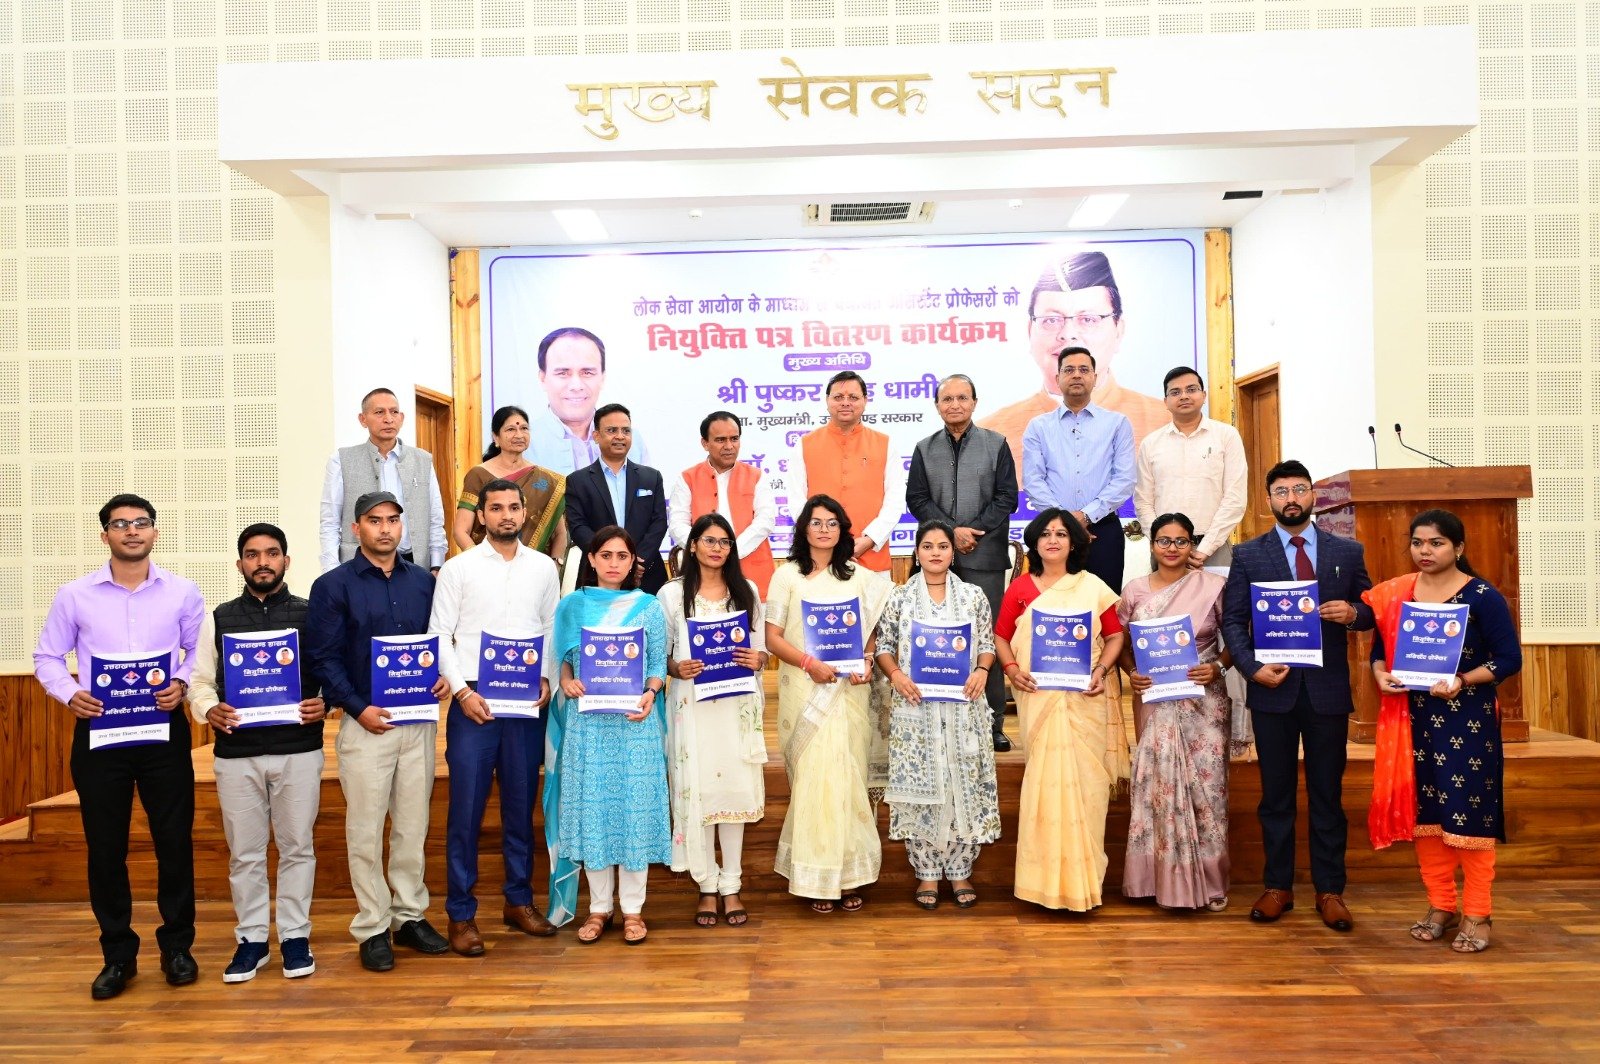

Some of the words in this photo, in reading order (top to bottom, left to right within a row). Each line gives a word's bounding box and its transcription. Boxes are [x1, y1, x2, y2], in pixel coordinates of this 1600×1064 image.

[565, 80, 718, 140] मुख्य
[758, 57, 933, 120] सेवक
[968, 66, 1117, 118] सदन
[633, 296, 661, 316] लोक
[665, 295, 693, 315] सेवा
[698, 294, 744, 314] आयोग
[748, 293, 761, 313] के
[945, 285, 998, 309] प्रोफेसरों
[1003, 287, 1020, 306] को
[647, 322, 748, 358] नियुक्ति
[755, 327, 794, 347] पत्र
[802, 320, 892, 347] वितरण
[900, 316, 1008, 345] कार्यक्रम
[787, 355, 821, 371] मुख्य
[824, 353, 866, 366] अतिथि
[717, 378, 748, 403] श्री
[754, 383, 823, 413] पुष्कर
[884, 373, 939, 400] धामी
[881, 412, 923, 423] सरकार
